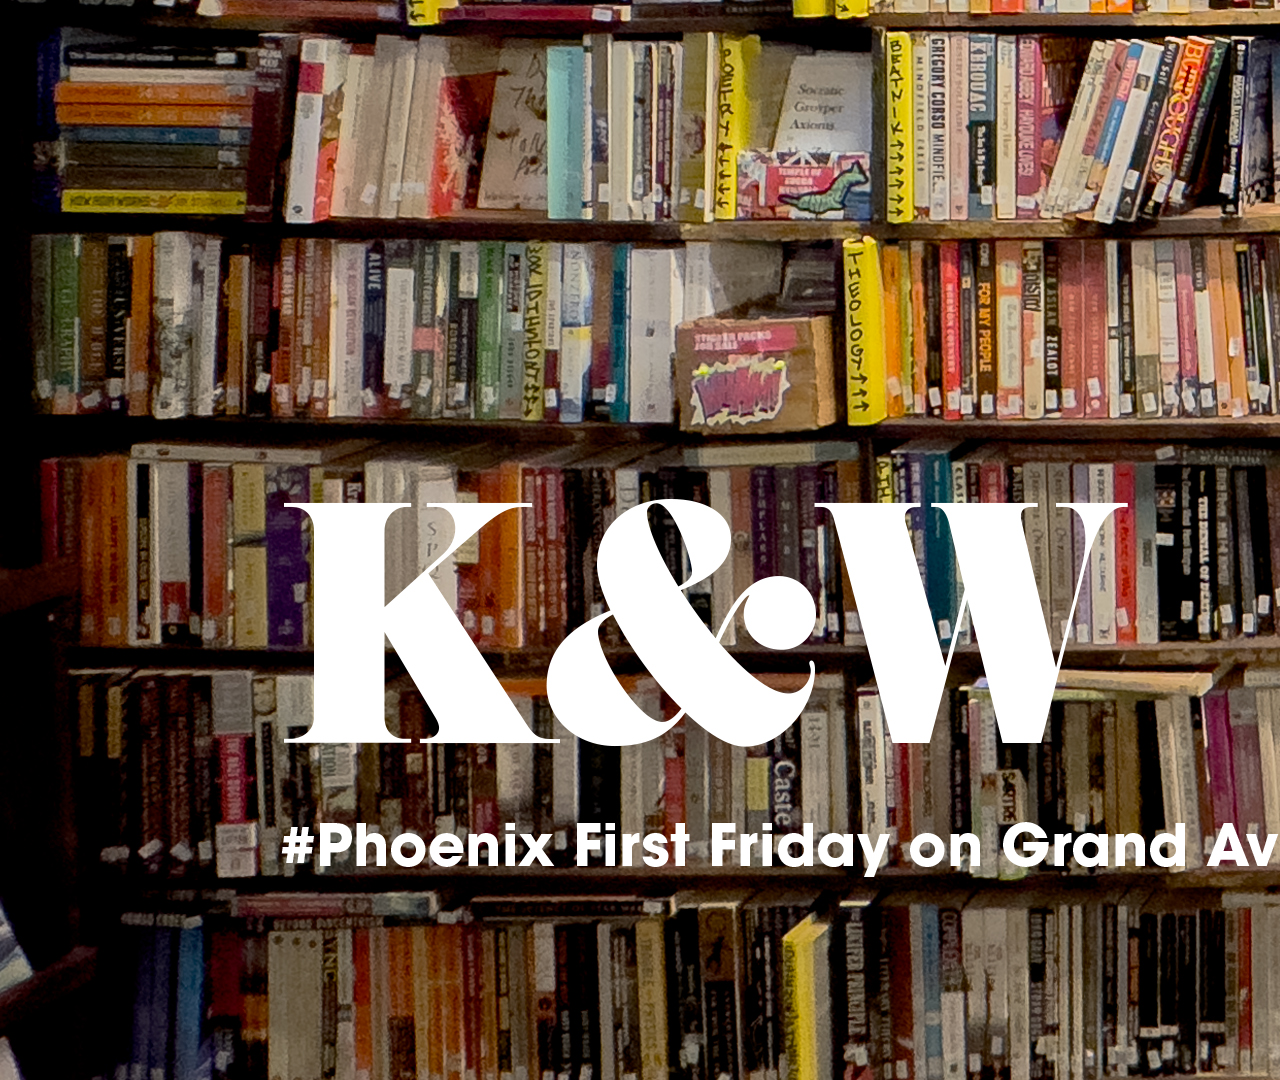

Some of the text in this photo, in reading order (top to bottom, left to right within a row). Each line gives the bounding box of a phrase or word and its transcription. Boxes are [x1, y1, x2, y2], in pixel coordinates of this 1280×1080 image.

[718, 48, 735, 133] POETRY
[889, 40, 904, 133] BEATNIK
[930, 39, 945, 129] GREGORY CORSO
[969, 41, 987, 112] KEROUAC
[1150, 43, 1205, 173] BURROUGHS
[367, 252, 382, 291] ALIVE
[848, 251, 865, 371] THEOLOGY
[978, 281, 992, 372] FOR MY PEOPLE
